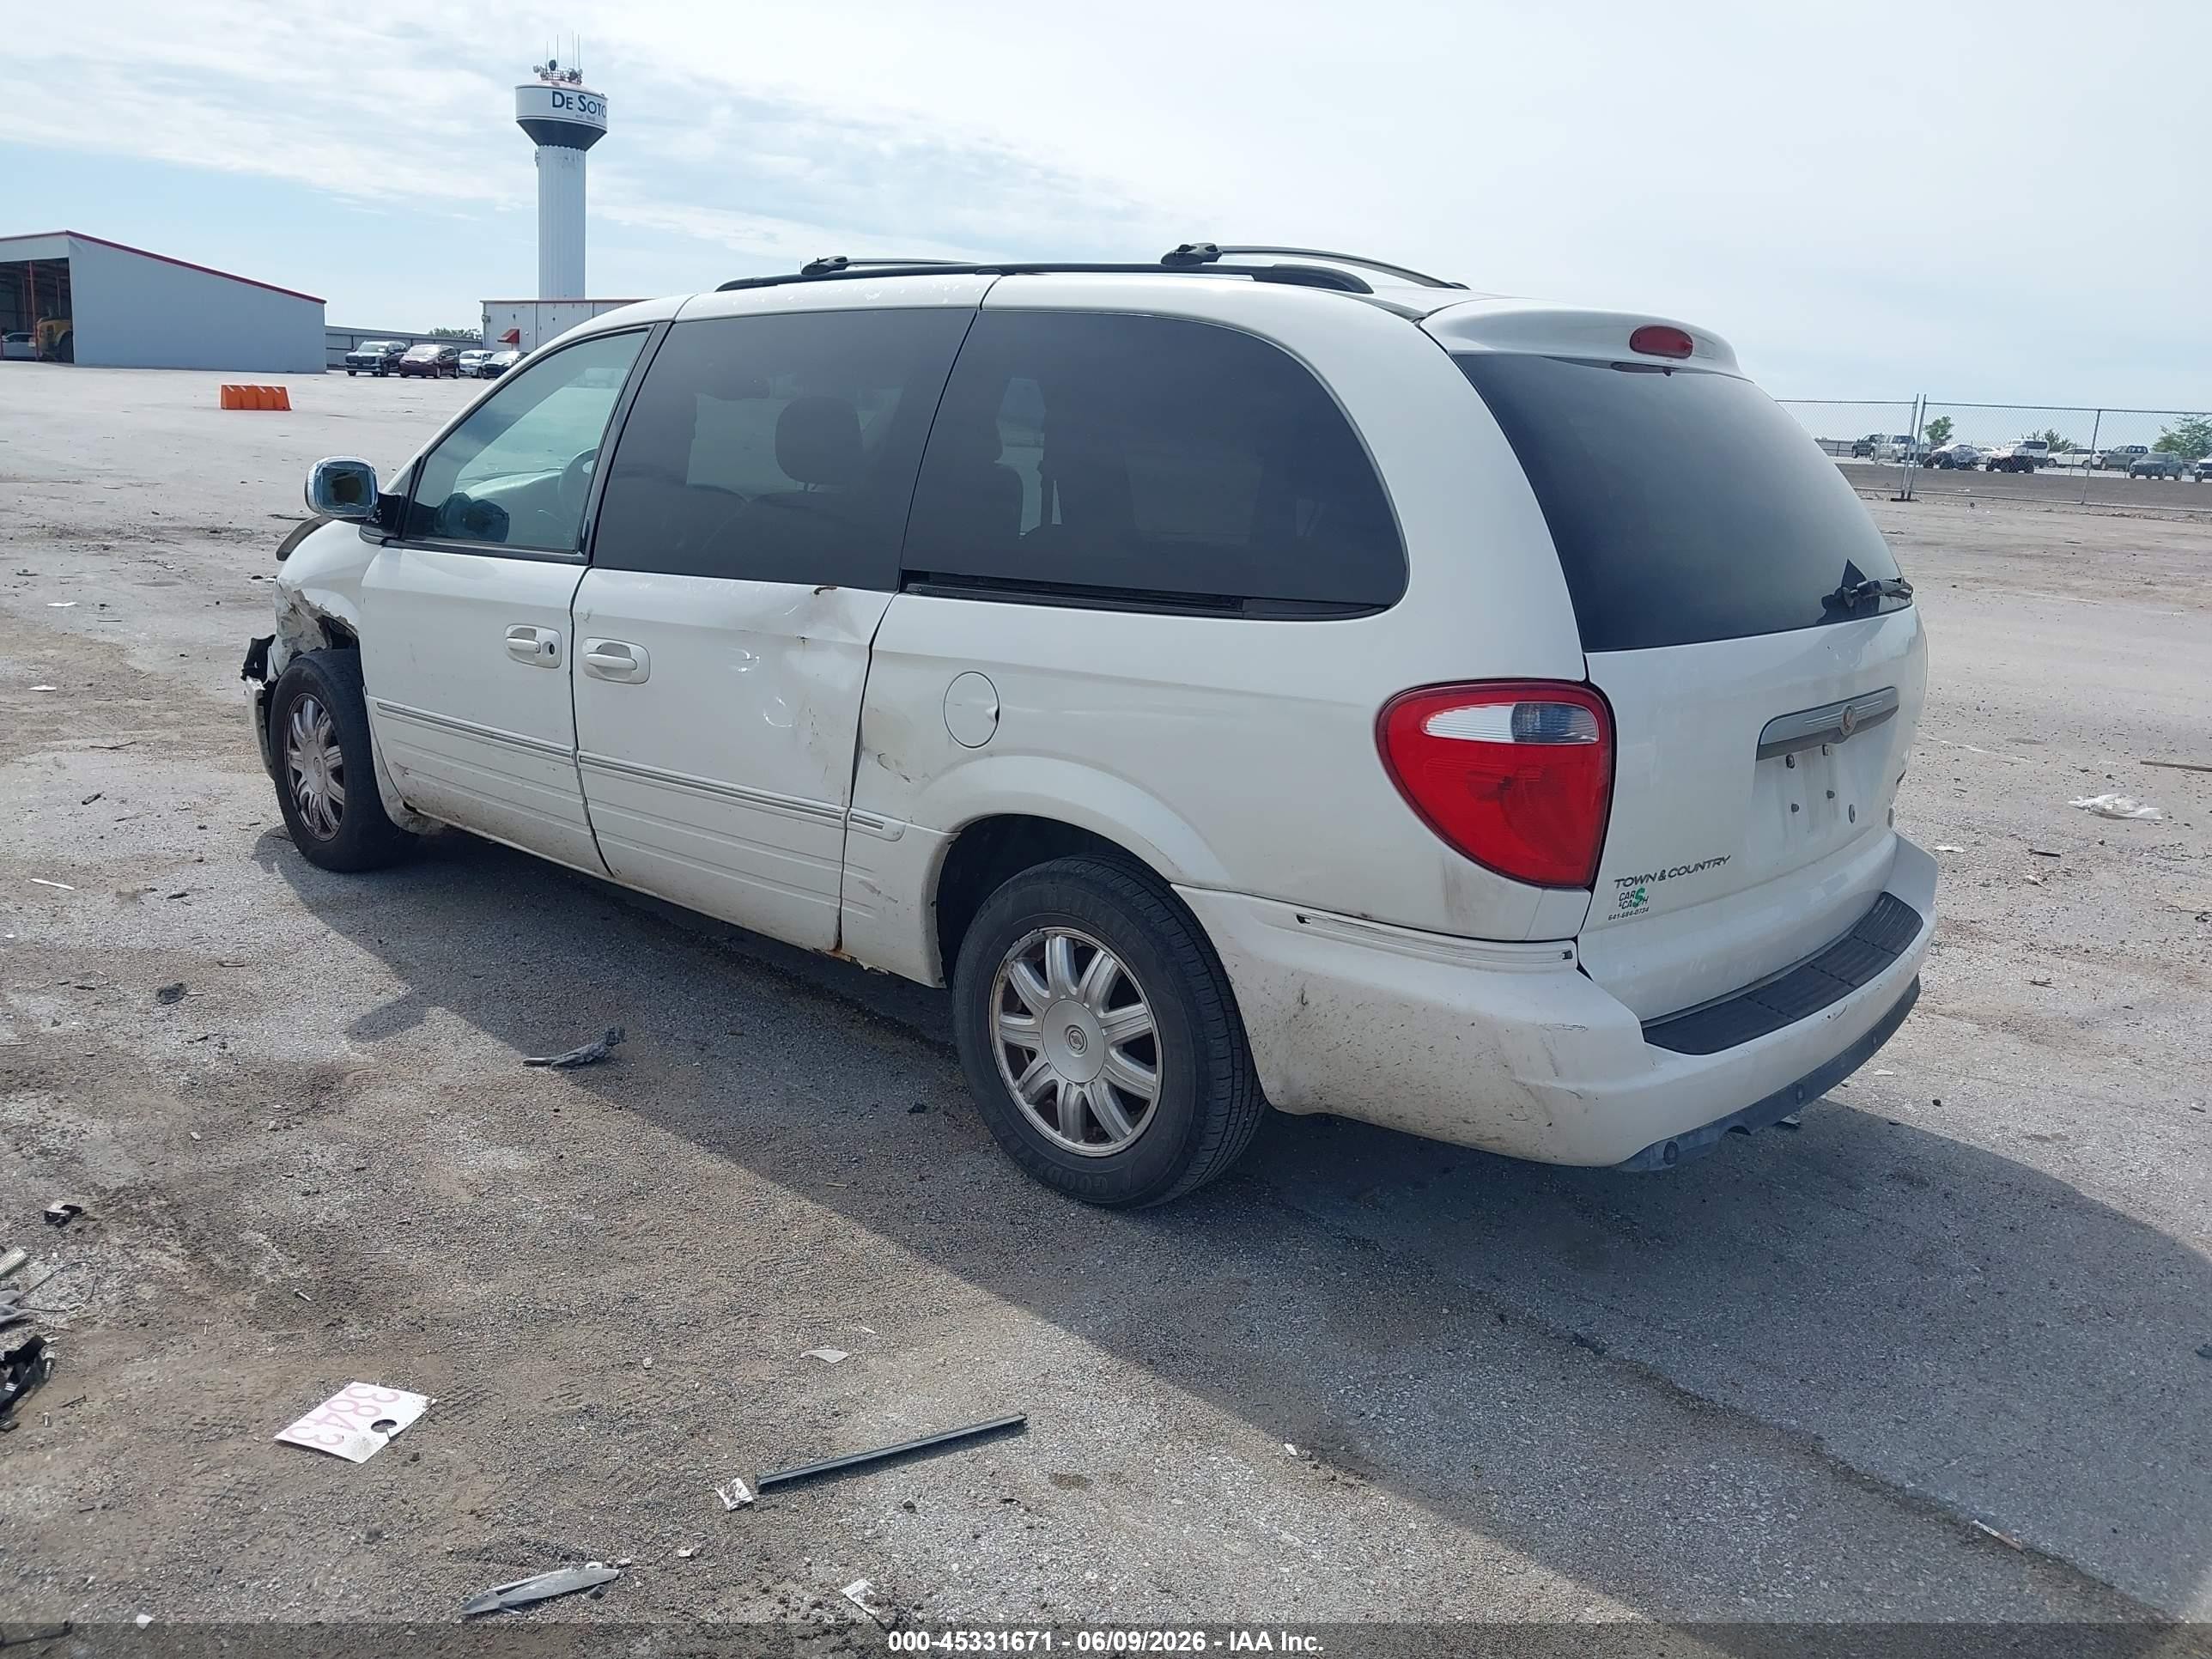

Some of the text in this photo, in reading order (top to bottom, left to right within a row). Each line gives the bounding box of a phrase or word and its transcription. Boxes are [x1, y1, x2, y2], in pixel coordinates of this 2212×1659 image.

[1614, 854, 1731, 889] TOWN & COUNTRY
